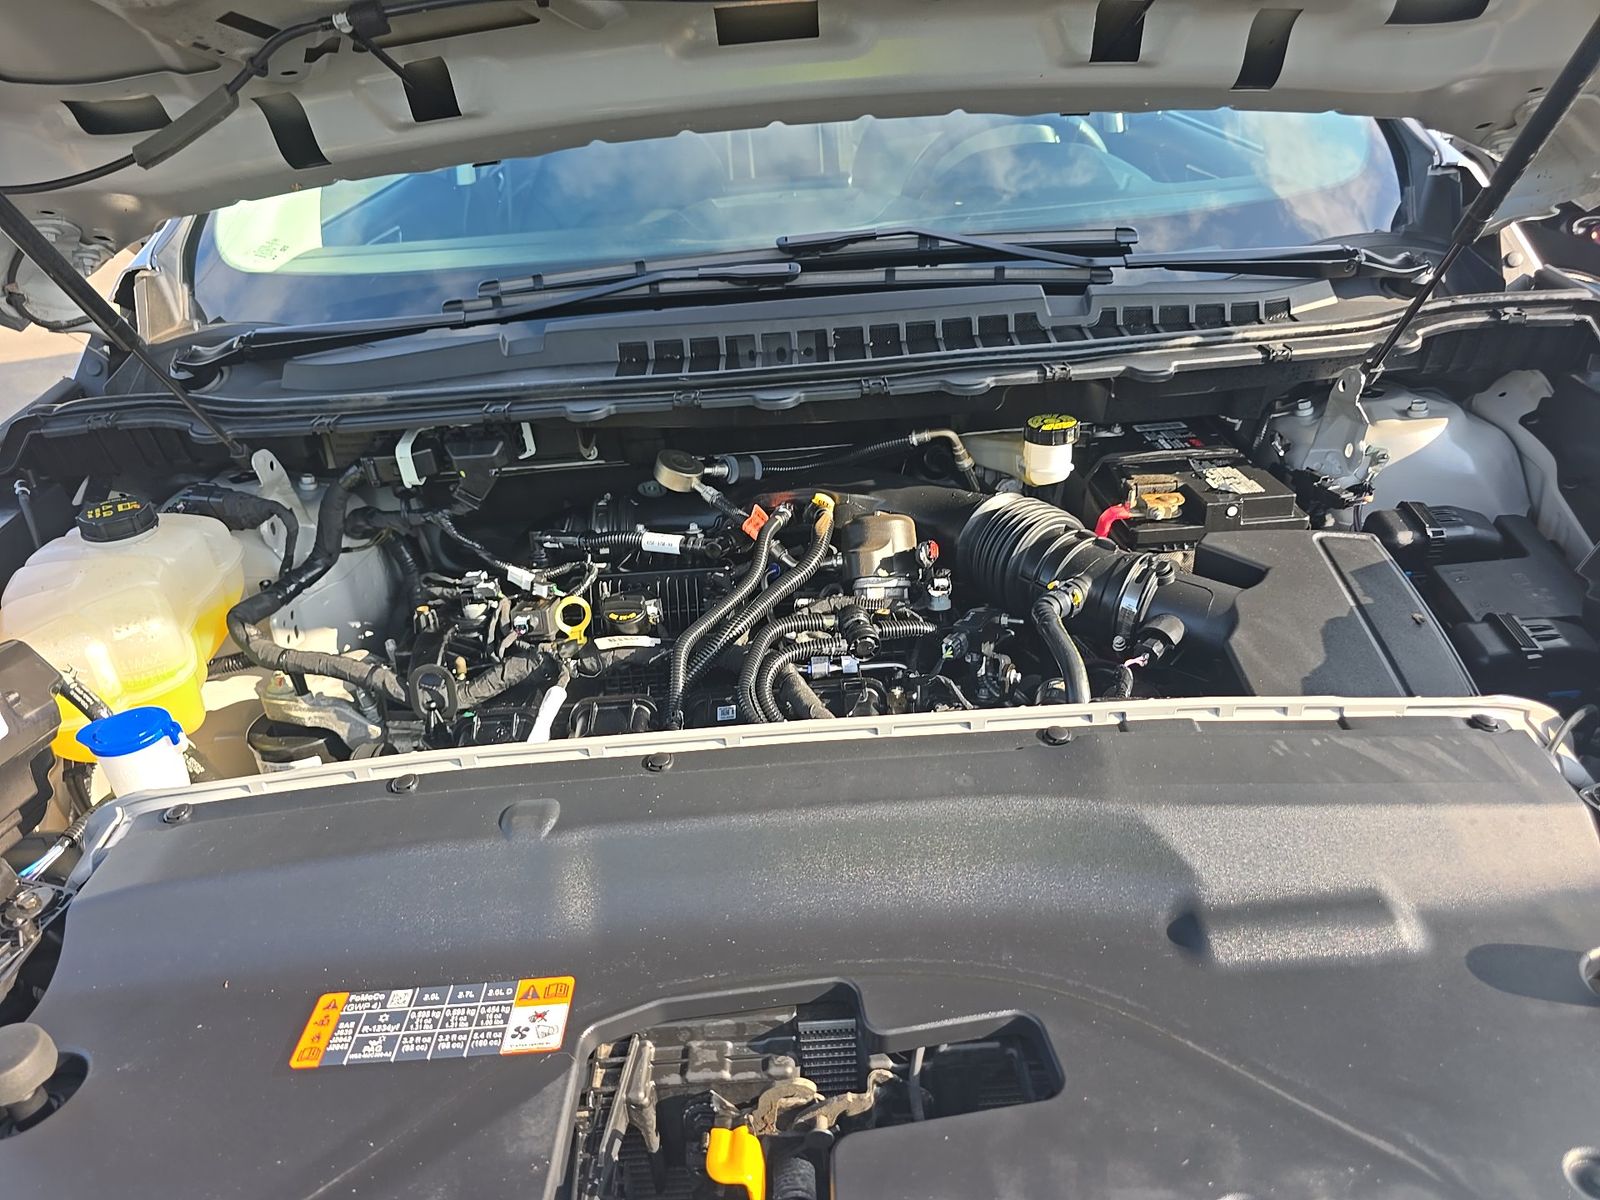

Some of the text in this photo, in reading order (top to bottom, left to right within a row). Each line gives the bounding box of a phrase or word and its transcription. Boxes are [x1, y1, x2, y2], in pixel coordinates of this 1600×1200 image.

[349, 993, 385, 1002] FoMoCo
[343, 1001, 381, 1012] (GWP 4)
[501, 1005, 510, 1014] kg
[431, 1010, 441, 1019] kg
[466, 1007, 476, 1017] kg
